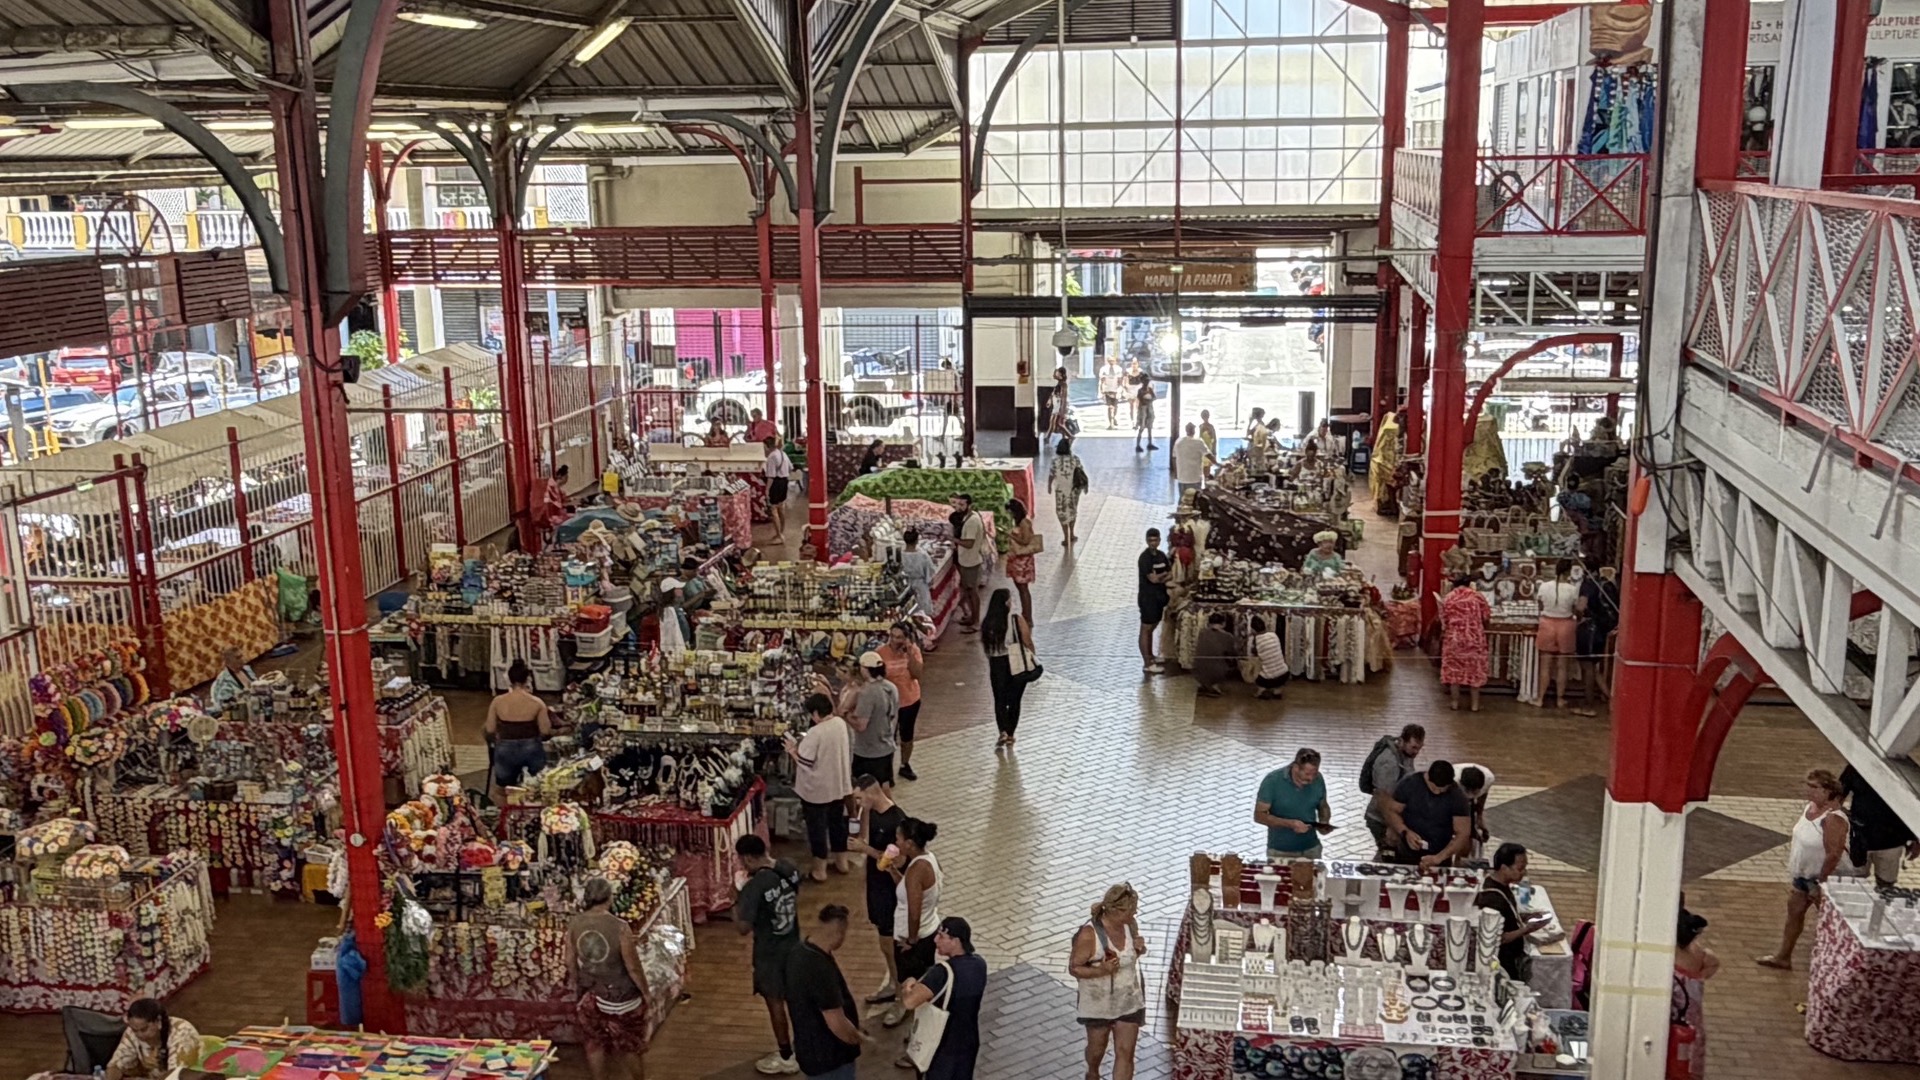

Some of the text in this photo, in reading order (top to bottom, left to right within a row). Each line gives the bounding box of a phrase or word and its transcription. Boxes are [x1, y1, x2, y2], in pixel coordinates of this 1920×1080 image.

[1749, 33, 1782, 43] RTISA
[1868, 28, 1920, 40] ULPTURE
[1145, 274, 1182, 287] MAPU
[1193, 273, 1232, 286] PARAITA
